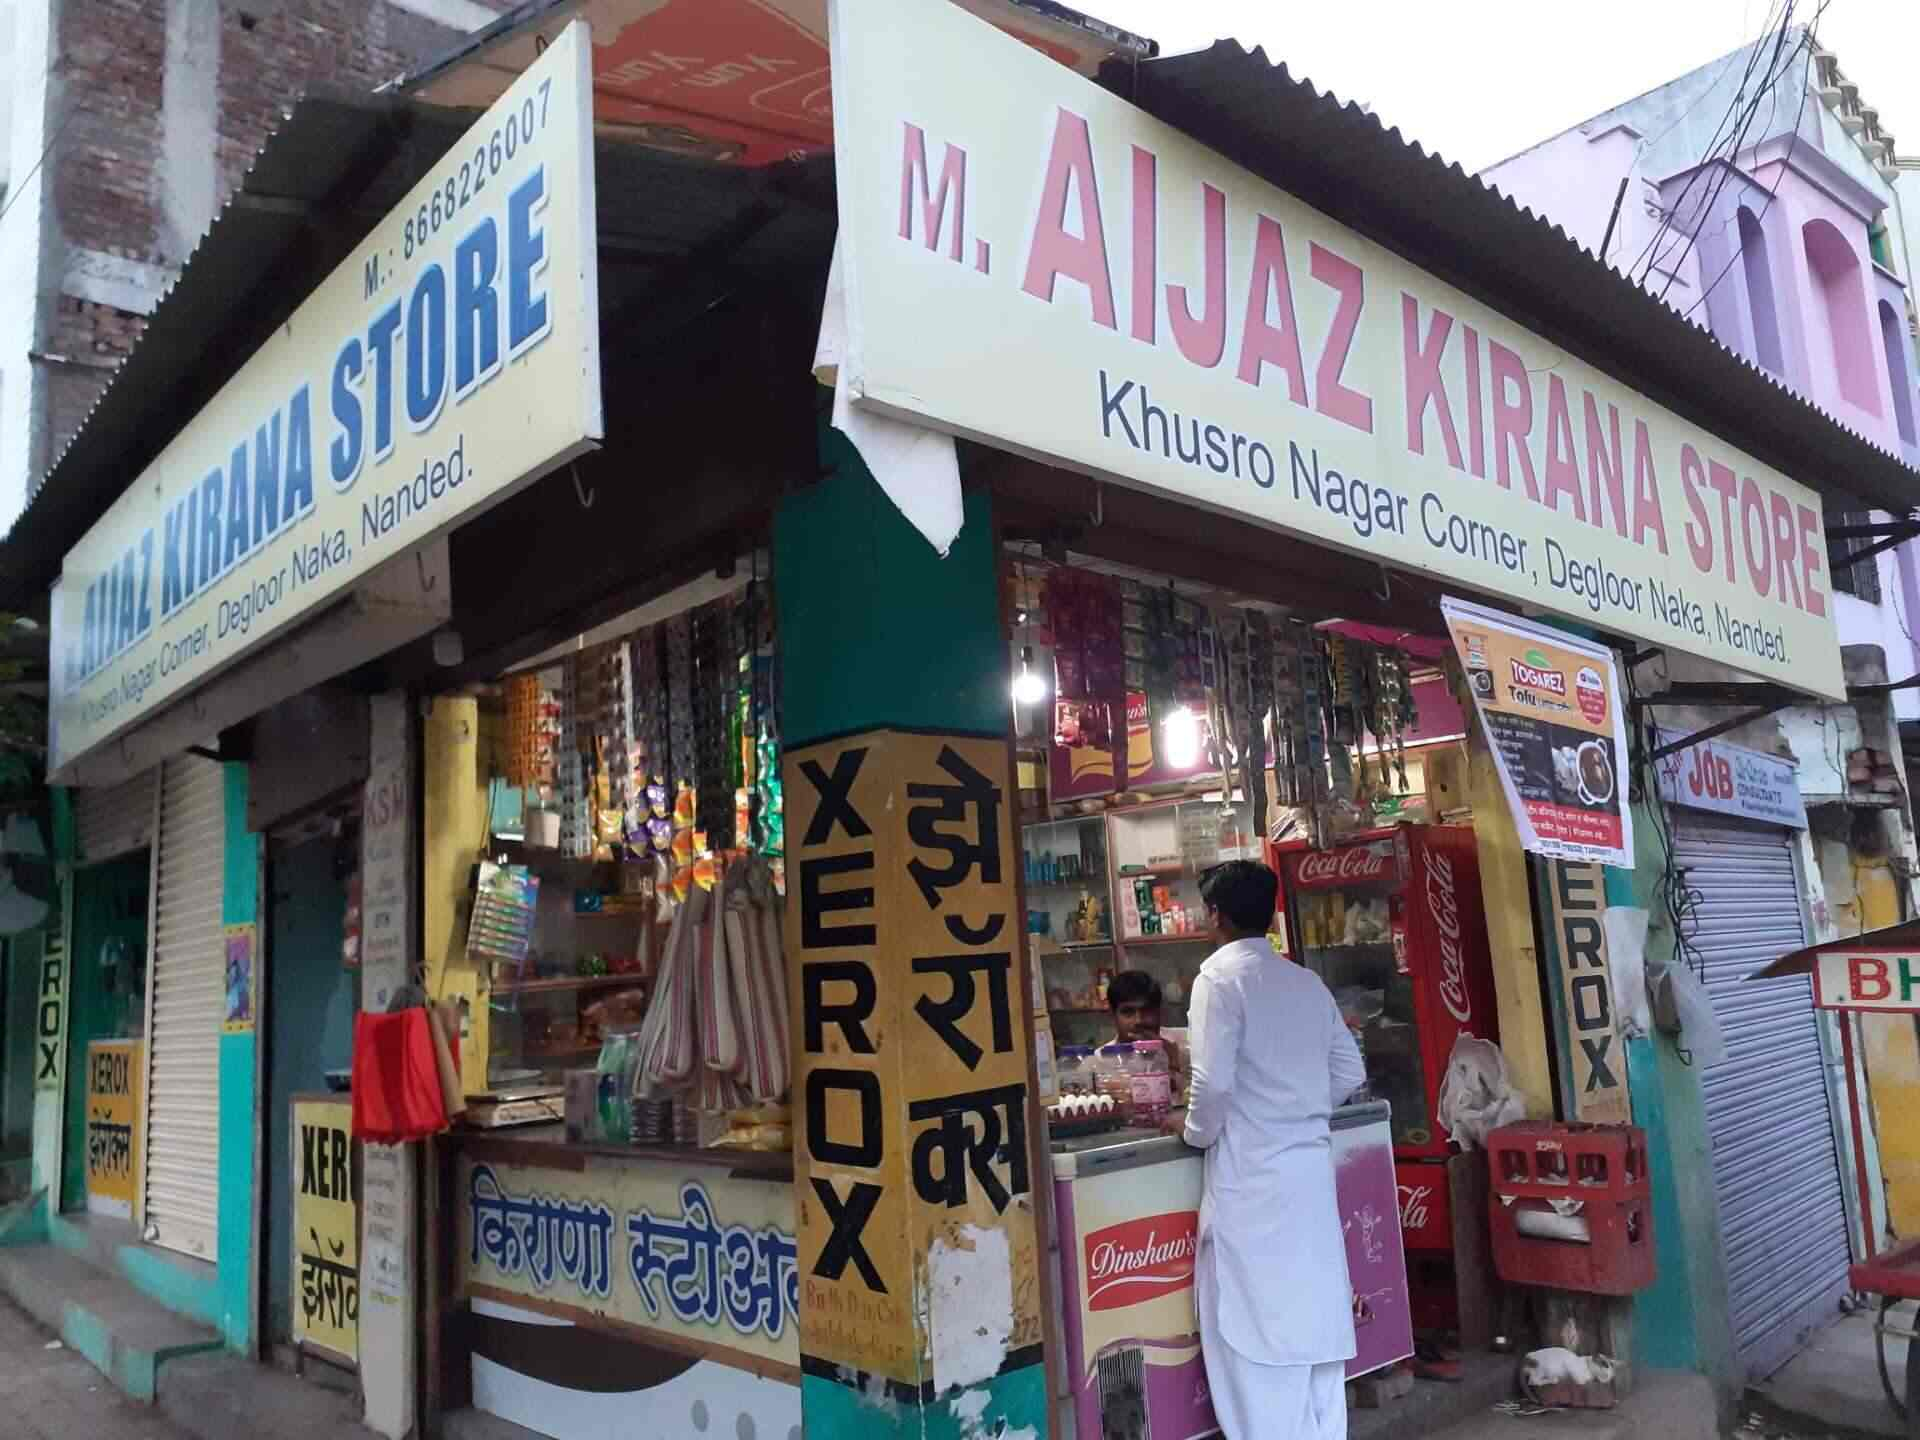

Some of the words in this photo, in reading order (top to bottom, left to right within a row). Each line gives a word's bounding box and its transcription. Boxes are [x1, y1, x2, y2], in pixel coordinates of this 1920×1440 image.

[404, 75, 552, 260] 8668226007
[80, 528, 154, 678] AIJAZ
[160, 384, 315, 618] KIRANA
[329, 164, 549, 486] STORE
[898, 121, 990, 276] M.
[1021, 106, 1374, 434] AIJAZ
[1401, 289, 1669, 556] KIRANA
[1680, 442, 1827, 619] STORE
[217, 566, 286, 639] Degloor
[292, 530, 352, 589] Naka,
[362, 434, 473, 540] Nanded.
[1099, 369, 1275, 488] Khusro
[1289, 440, 1408, 538] Nagar
[1545, 537, 1642, 614] Degloor
[1649, 576, 1711, 640] Naka,
[1715, 607, 1791, 666] Nanded.
[1688, 744, 1735, 800] JOB
[91, 1053, 130, 1096] XEROX
[797, 748, 889, 1294] XEROX
[1556, 858, 1619, 1093] EROX
[470, 1165, 614, 1294] किराणा
[1091, 1231, 1197, 1279] Dinshaw's
